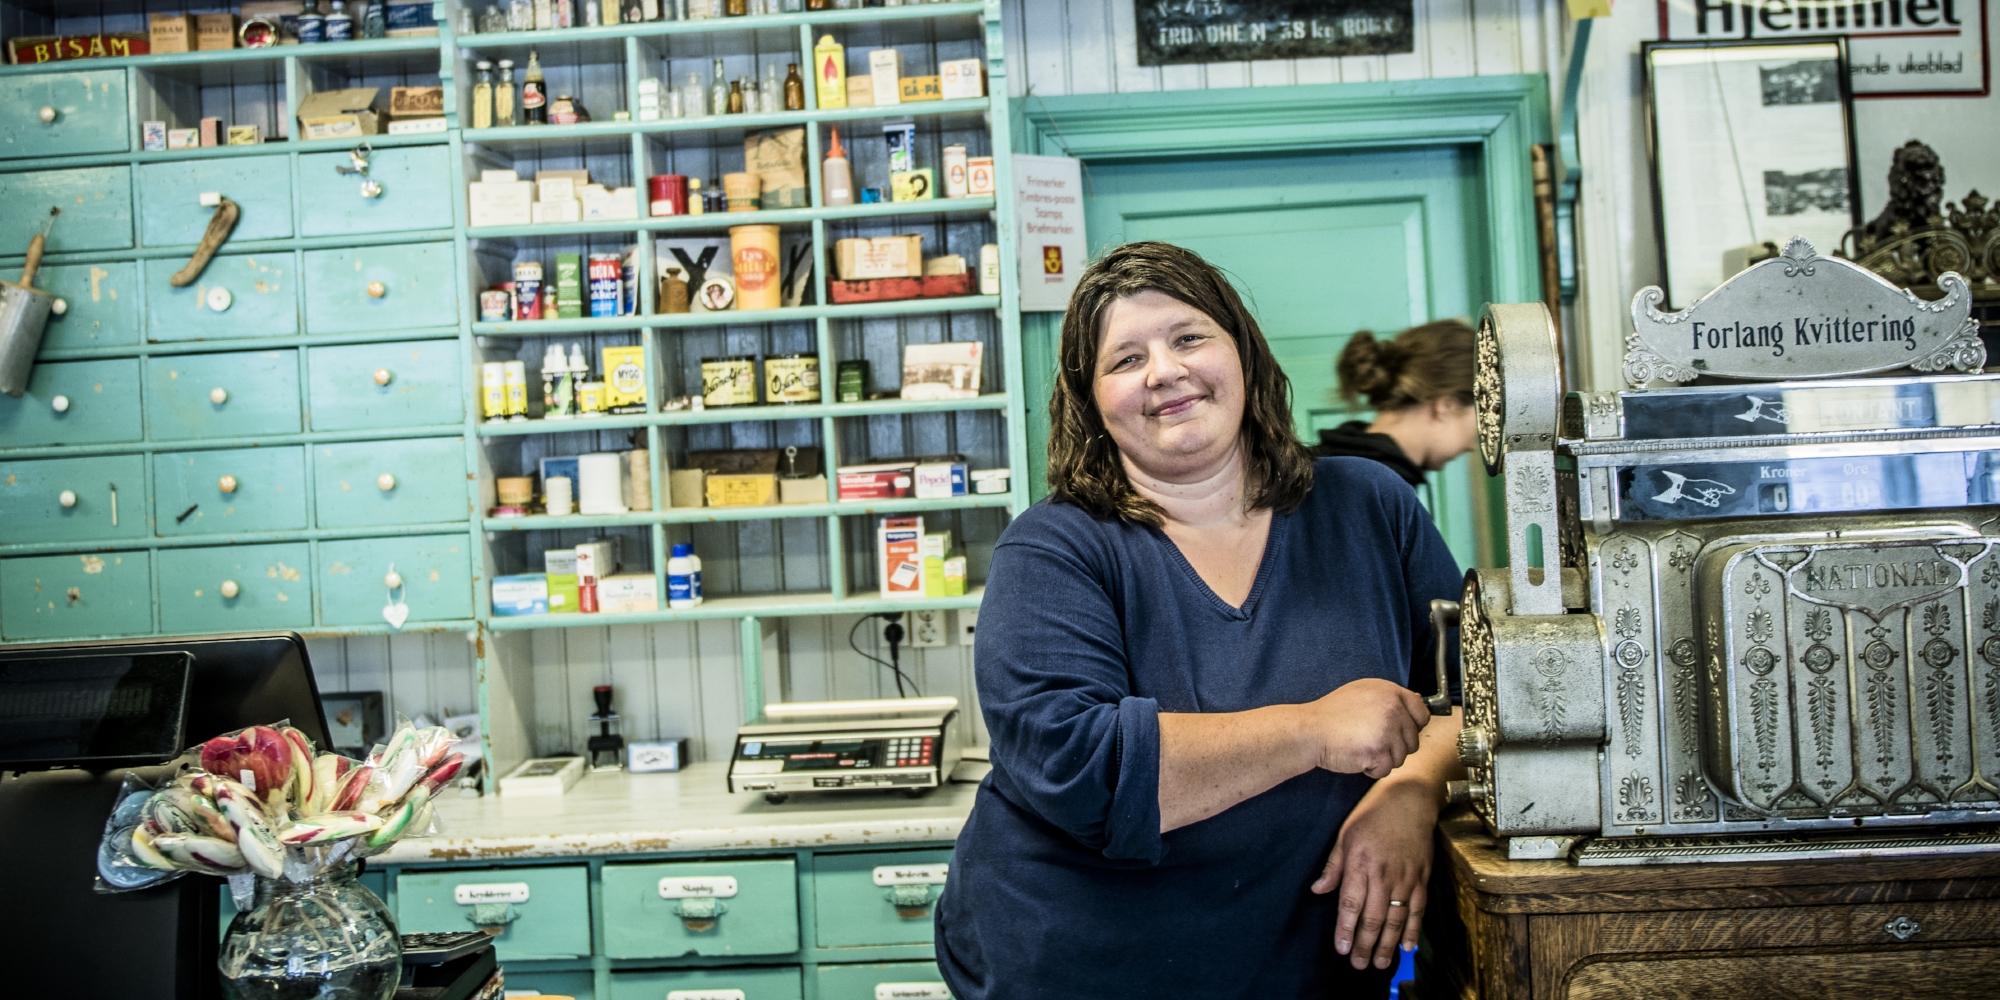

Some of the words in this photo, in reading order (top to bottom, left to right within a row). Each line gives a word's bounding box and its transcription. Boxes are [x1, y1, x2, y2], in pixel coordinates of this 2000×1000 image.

[34, 37, 130, 63] BISAM
[1898, 51, 1963, 74] ukeblad
[1692, 320, 1784, 357] Forlang
[1794, 313, 1917, 351] Kvittering
[618, 369, 640, 379] MYGG
[1826, 400, 1916, 420] ONTANT
[1760, 465, 1807, 480] Kroner
[1843, 462, 1869, 476] Øre
[1807, 561, 1949, 592] NATIONAL
